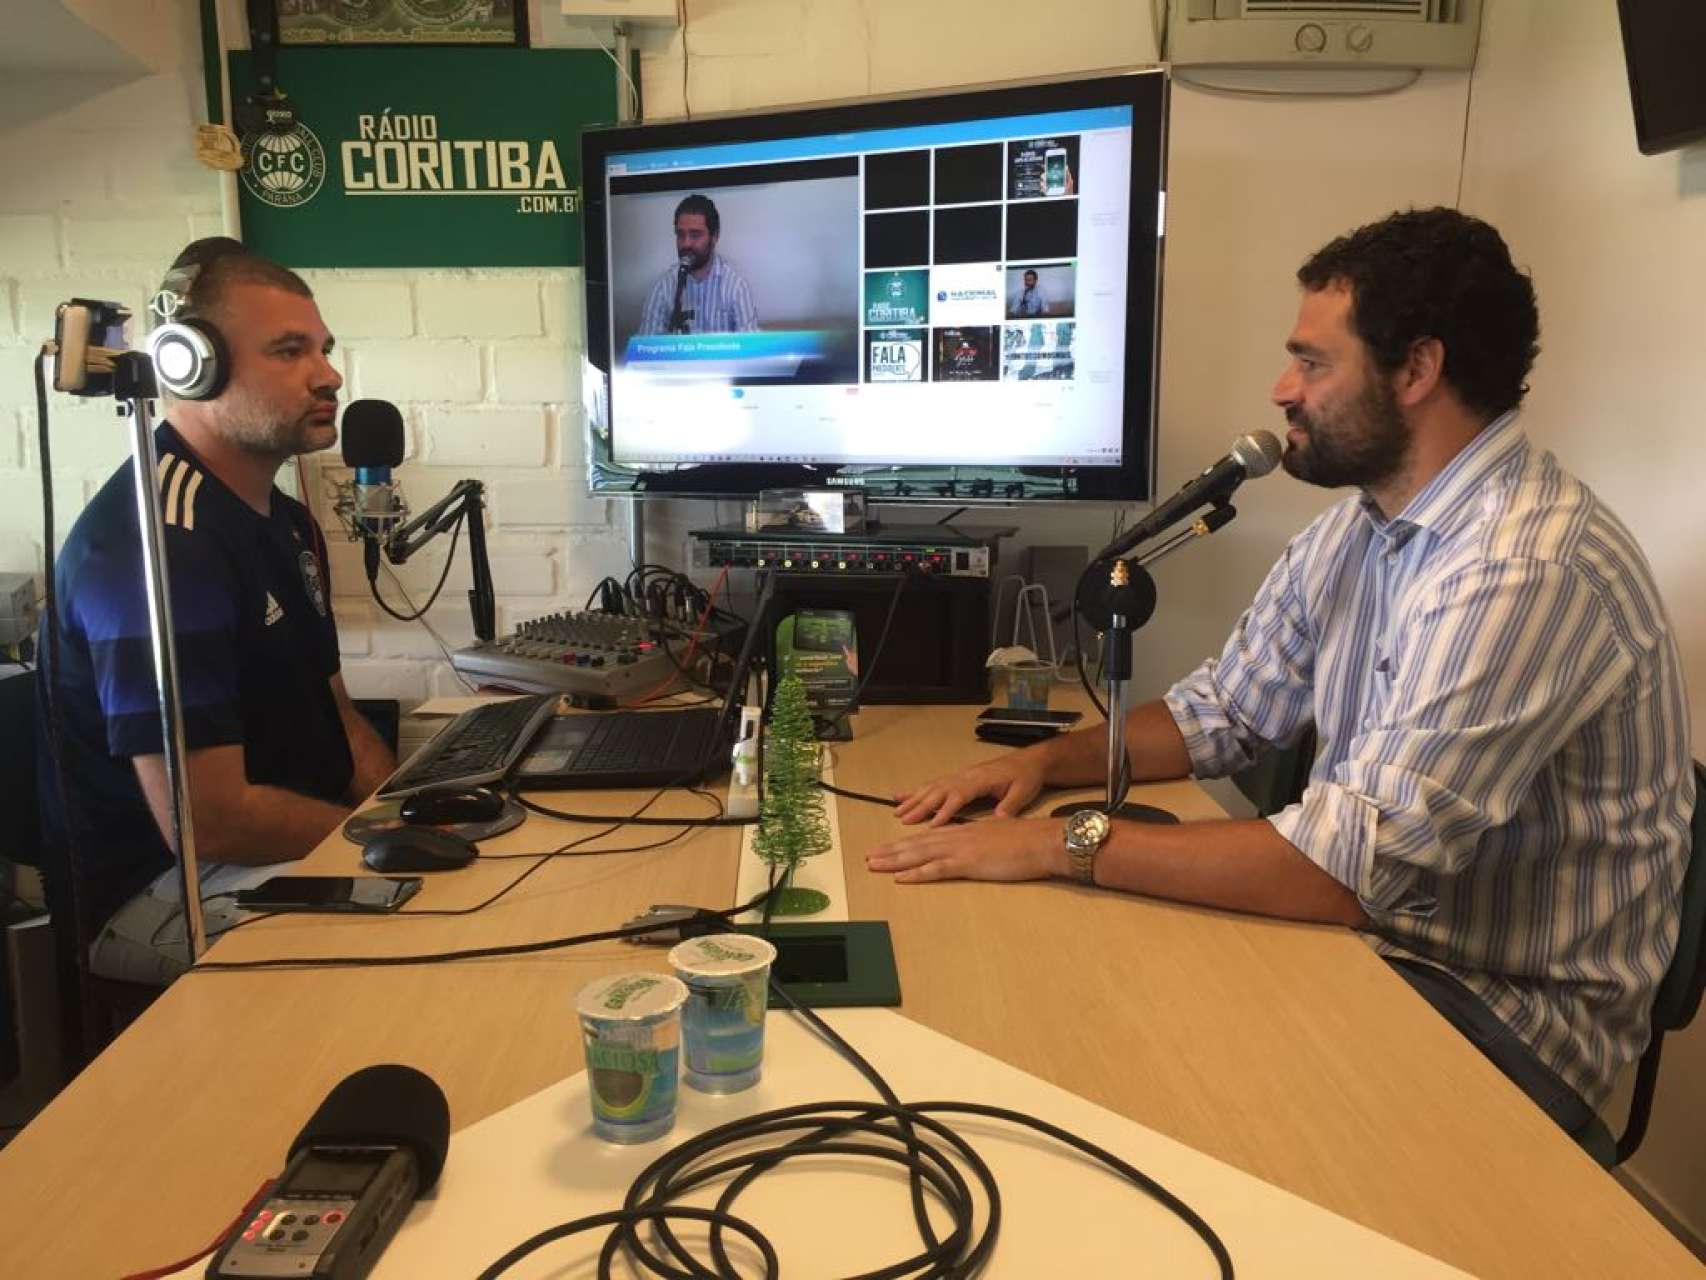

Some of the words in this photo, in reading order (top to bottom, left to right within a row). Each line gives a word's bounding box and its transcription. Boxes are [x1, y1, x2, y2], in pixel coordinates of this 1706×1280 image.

[359, 107, 438, 141] RÁDIO
[340, 139, 567, 190] CORITIBA
[872, 345, 906, 364] FALA
